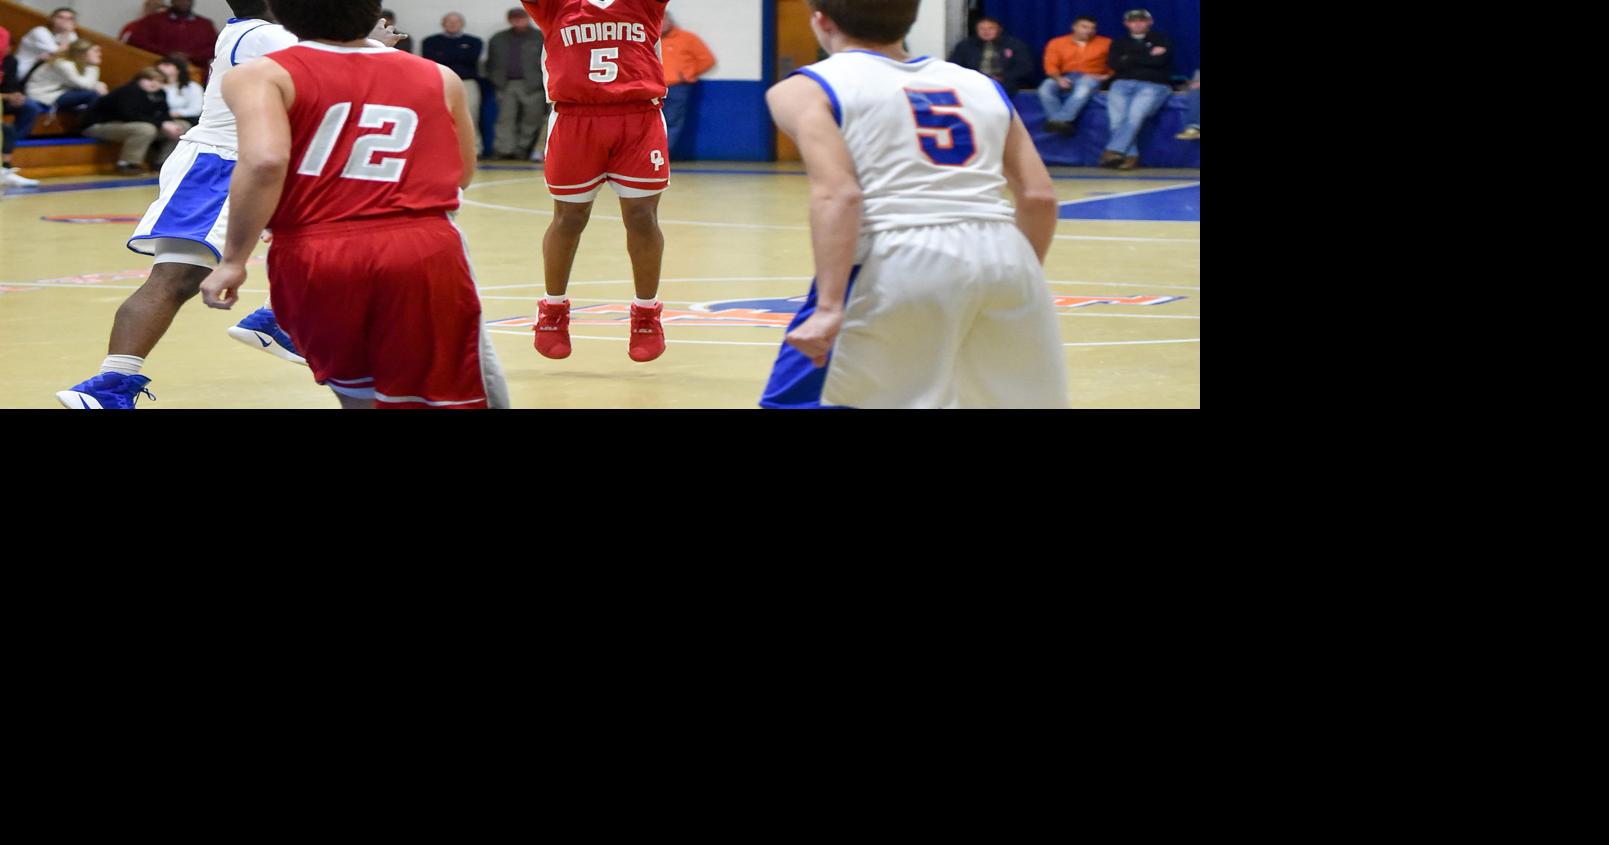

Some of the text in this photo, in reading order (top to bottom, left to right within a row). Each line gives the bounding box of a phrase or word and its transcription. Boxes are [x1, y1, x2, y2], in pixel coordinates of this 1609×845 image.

[560, 22, 646, 47] INDIANS
[589, 47, 619, 83] 5
[297, 101, 419, 182] 12
[902, 87, 978, 167] 5
